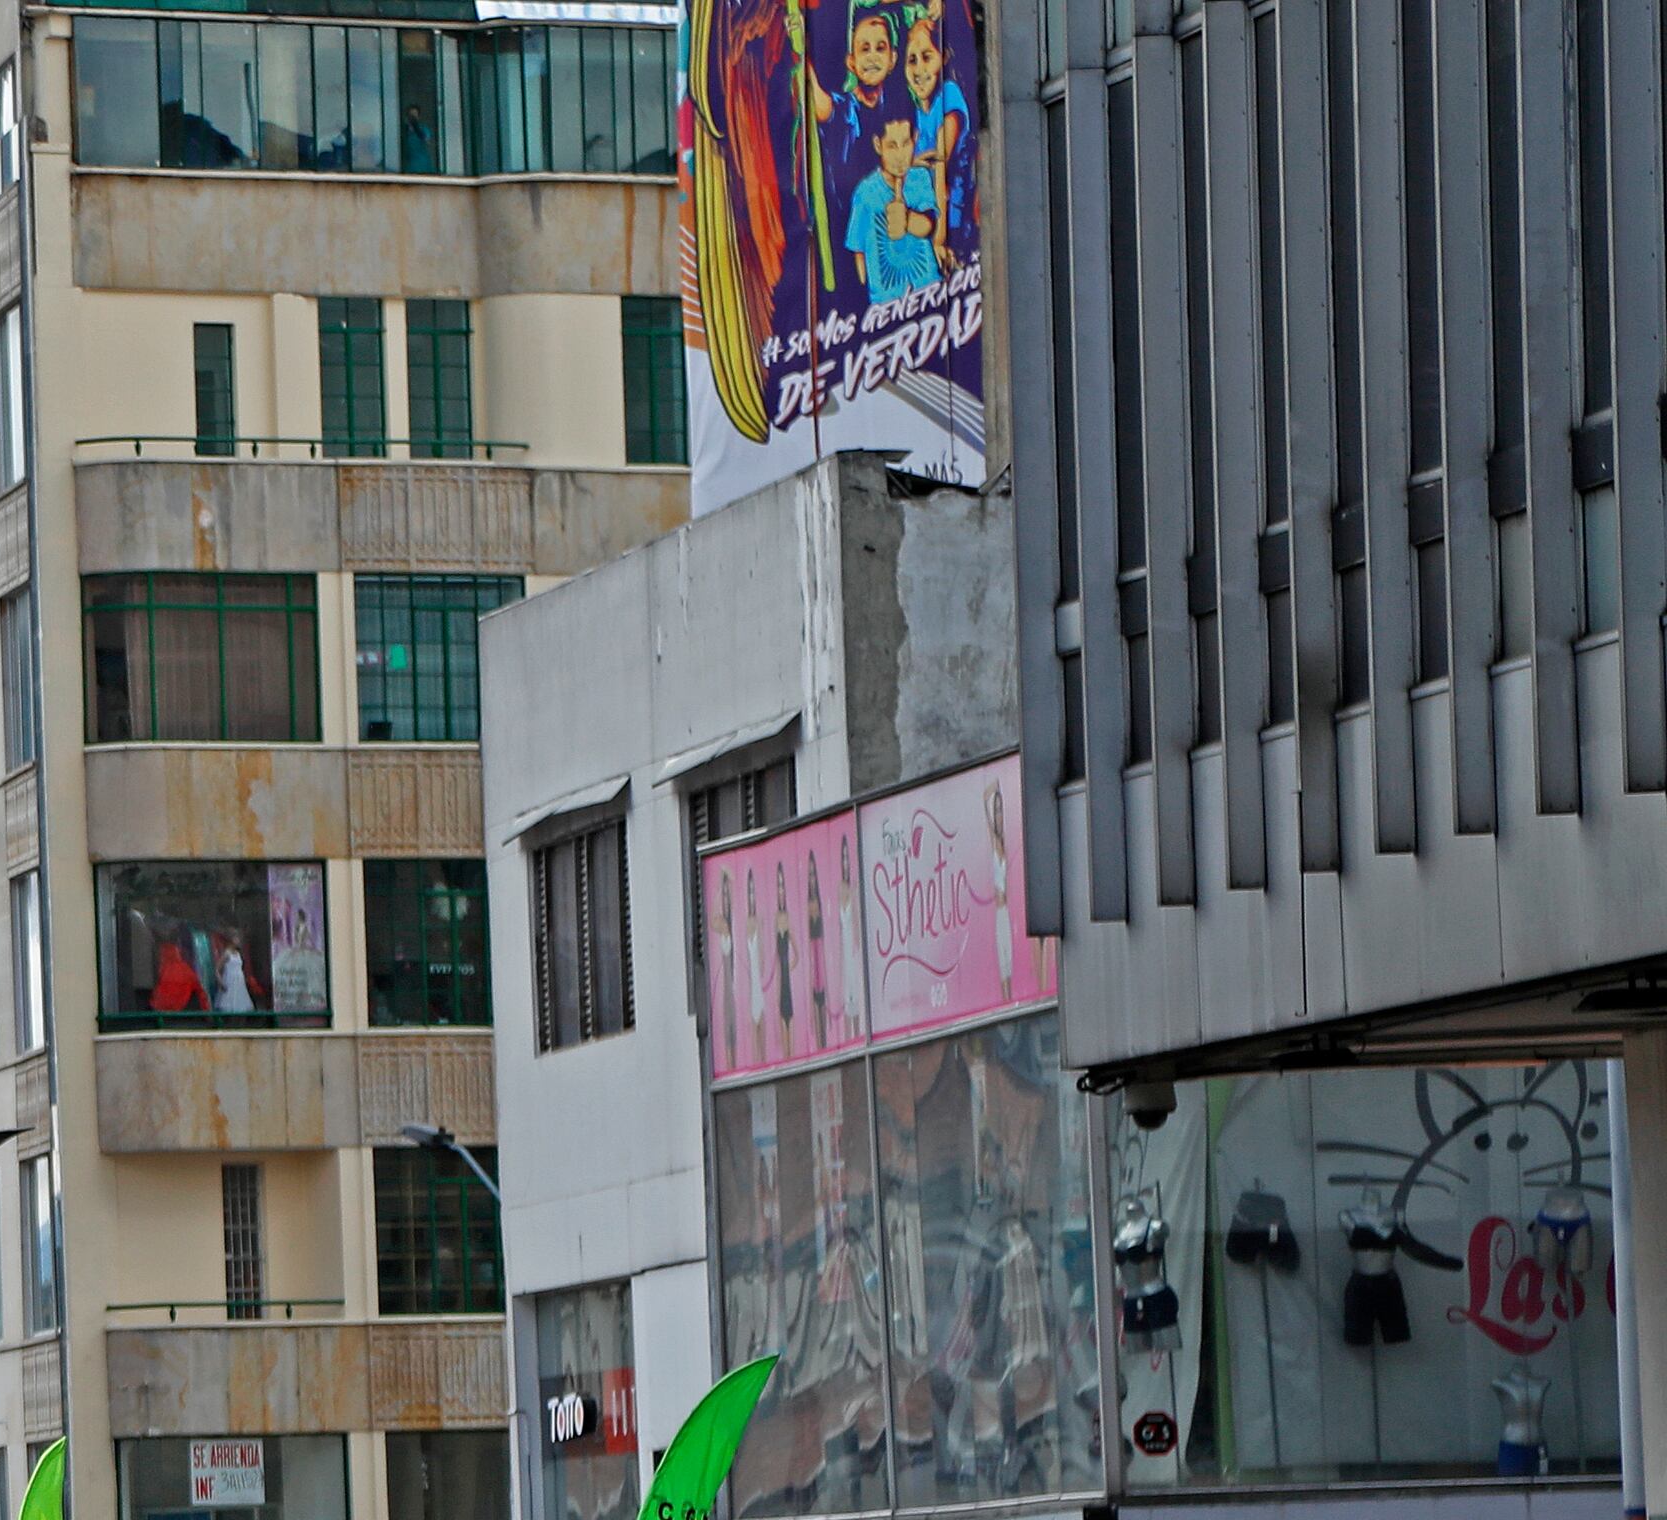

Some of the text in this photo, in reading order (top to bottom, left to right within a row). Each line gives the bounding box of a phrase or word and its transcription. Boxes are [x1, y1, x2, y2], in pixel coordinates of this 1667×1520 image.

[774, 295, 983, 431] DE VERDAD
[193, 1443, 261, 1469] SE ARRIENDA
